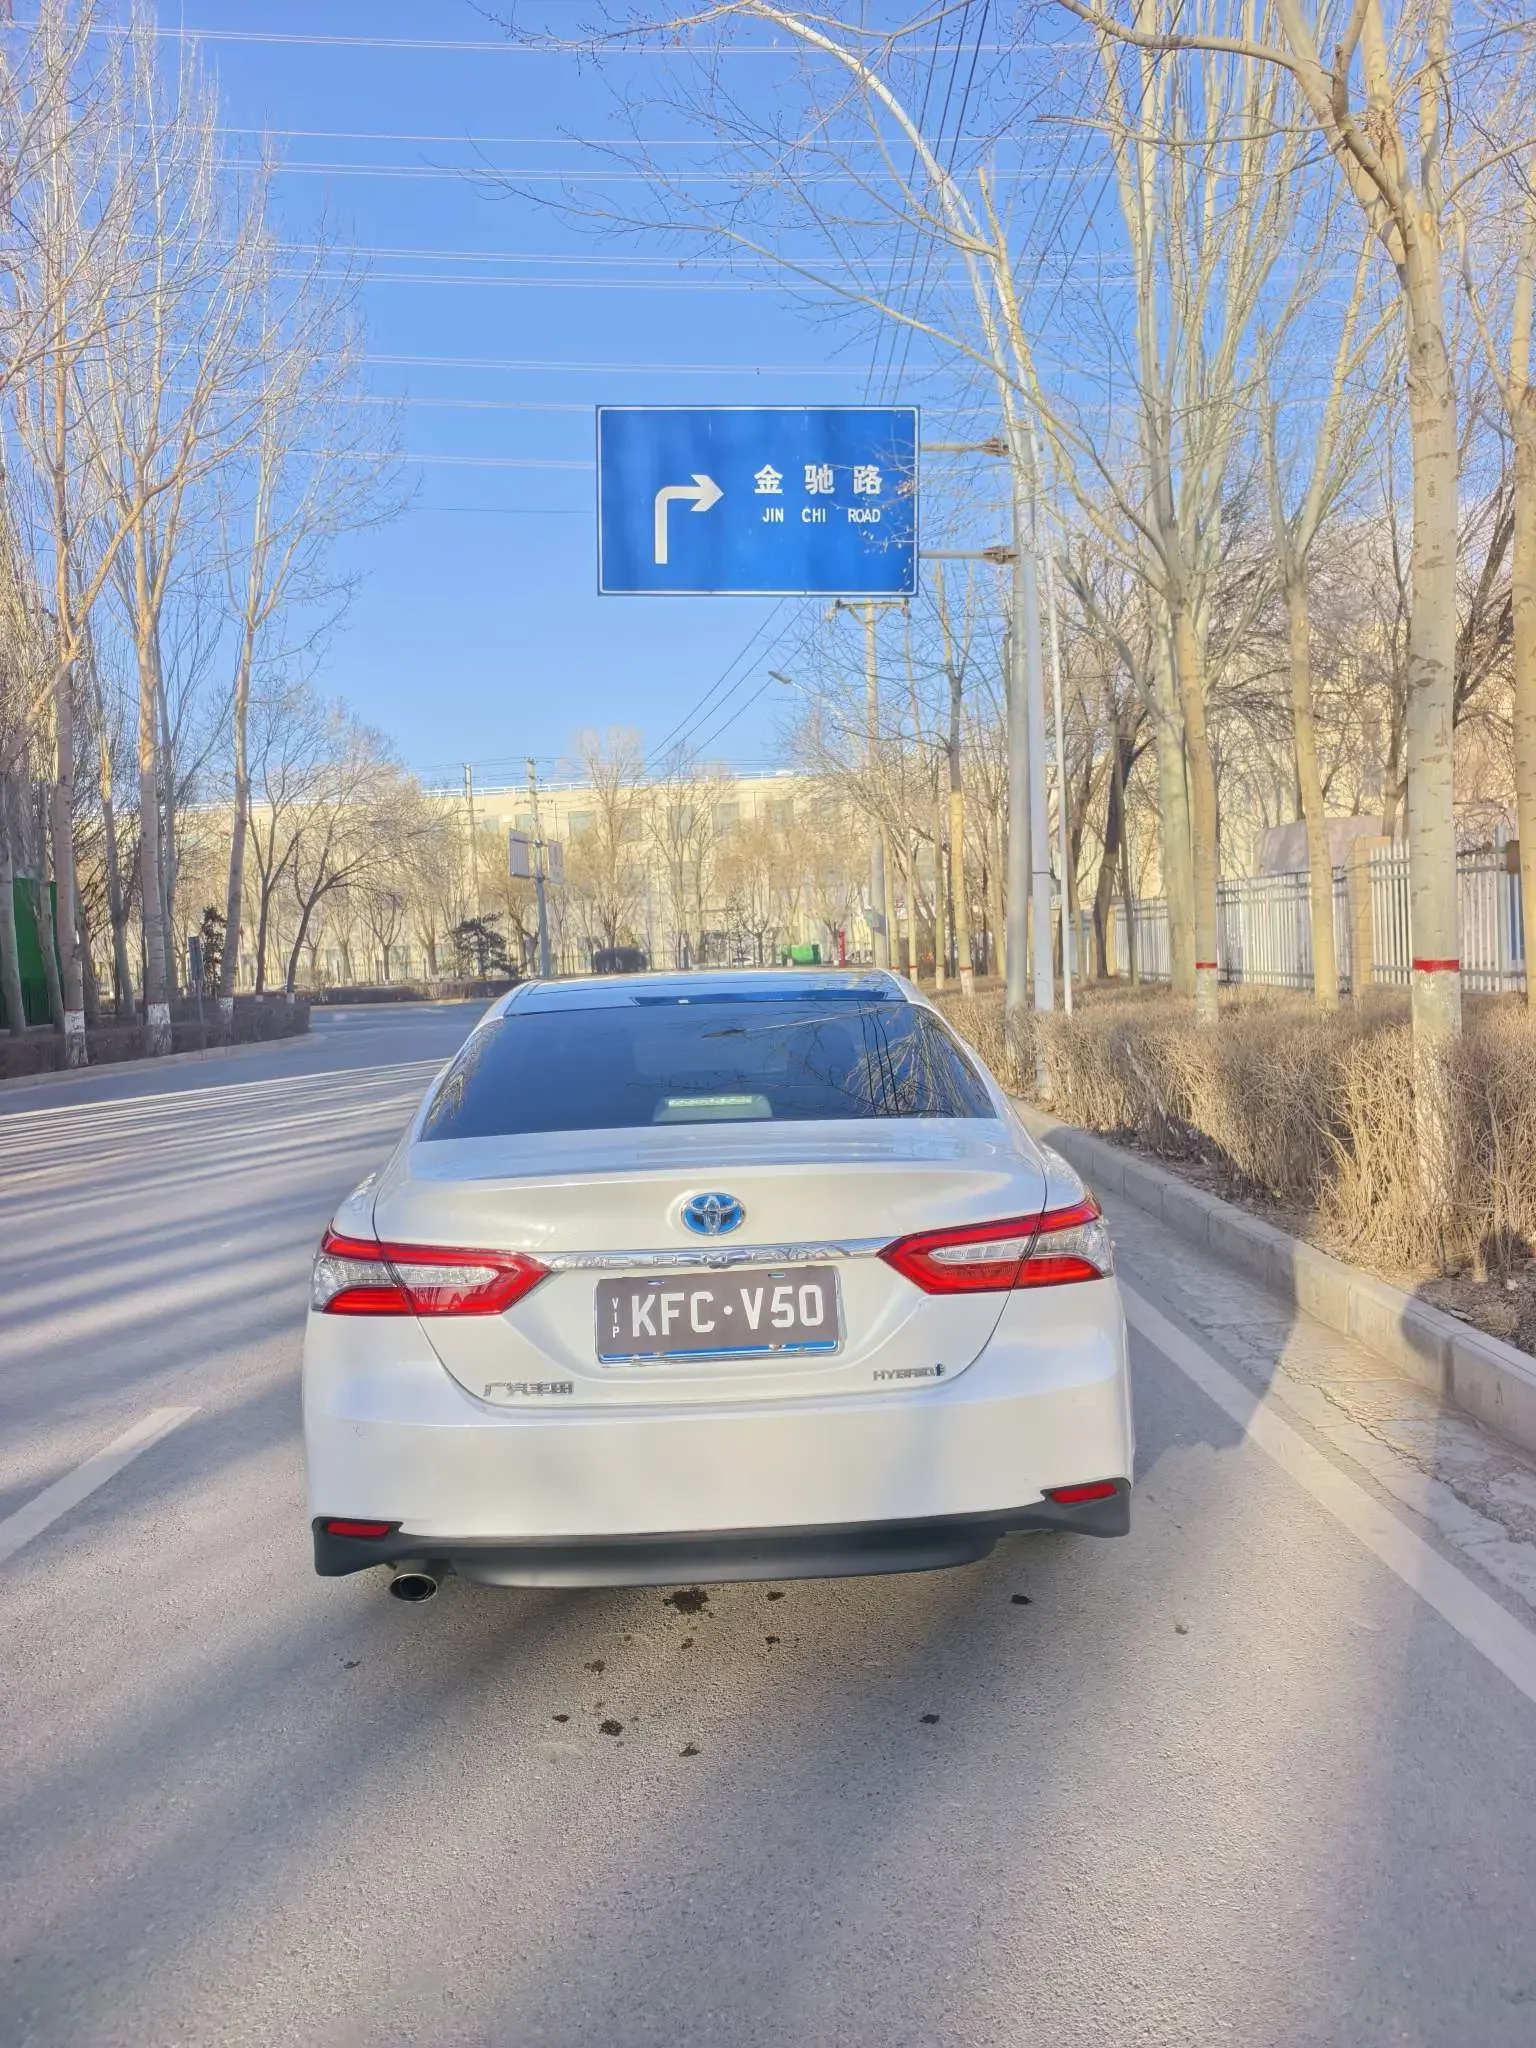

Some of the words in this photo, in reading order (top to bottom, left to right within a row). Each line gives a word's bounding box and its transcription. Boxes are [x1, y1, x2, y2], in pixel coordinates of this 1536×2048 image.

[753, 463, 883, 495] 金驰路
[762, 507, 784, 523] JIN
[801, 507, 826, 523] CHI
[847, 507, 881, 523] ROAD
[611, 1297, 620, 1339] VIP
